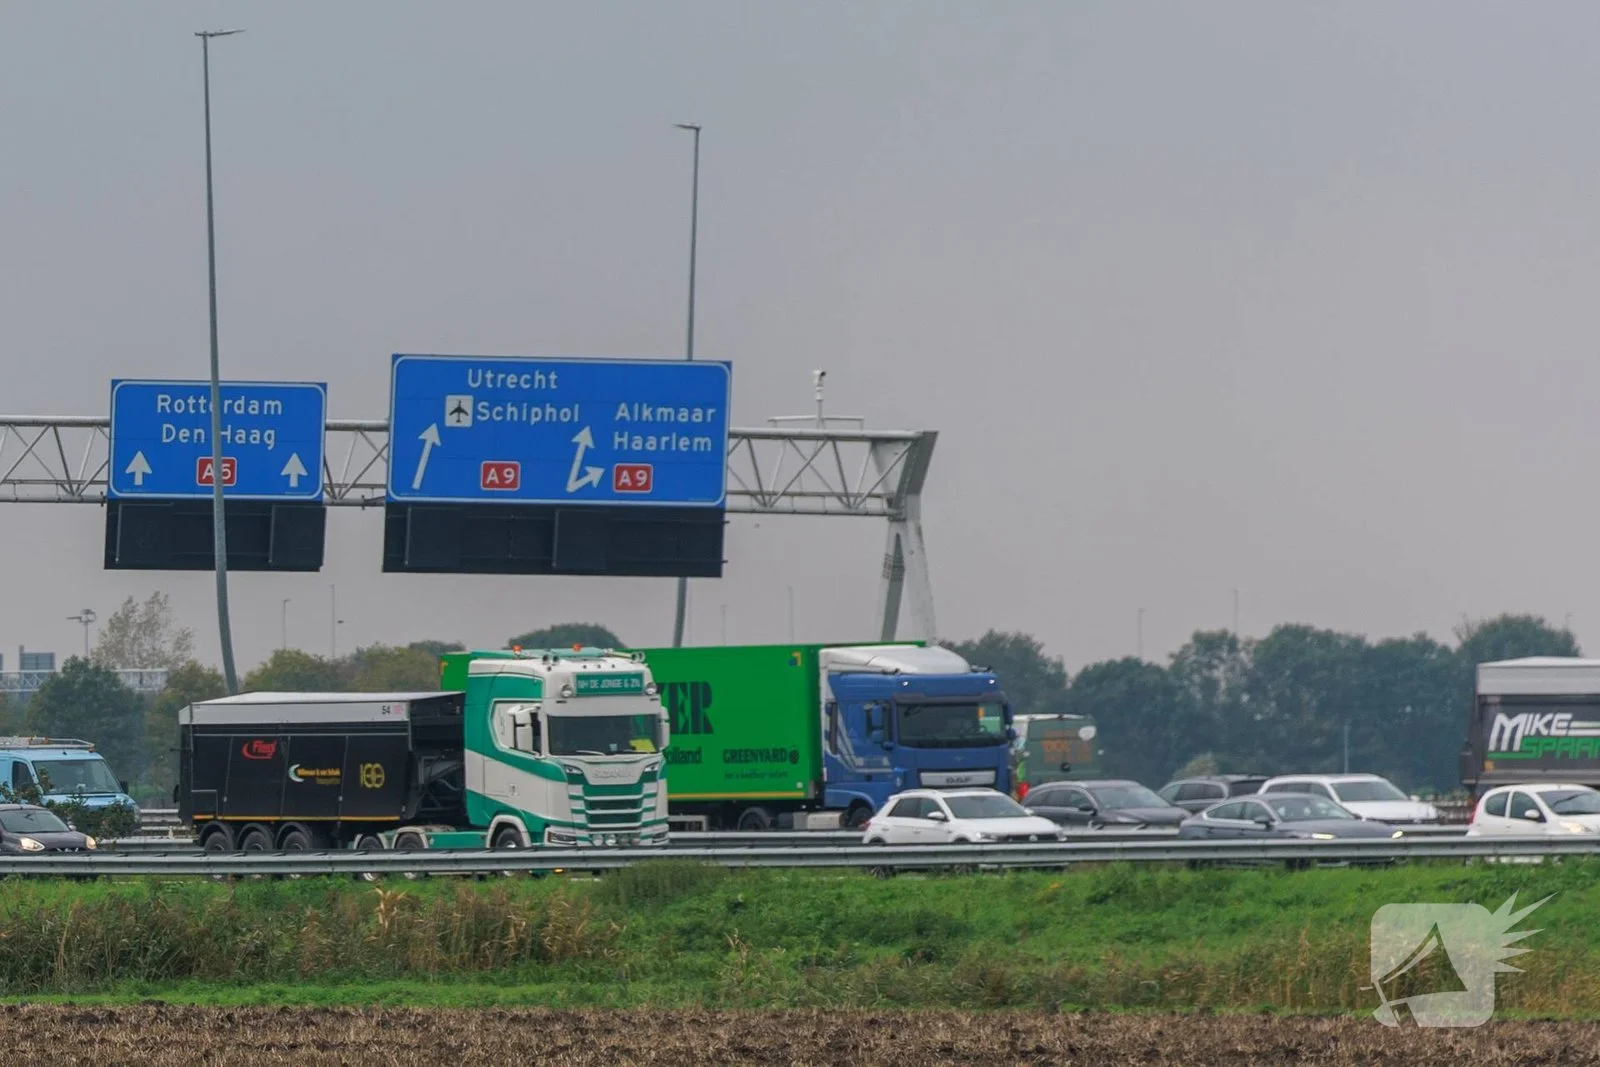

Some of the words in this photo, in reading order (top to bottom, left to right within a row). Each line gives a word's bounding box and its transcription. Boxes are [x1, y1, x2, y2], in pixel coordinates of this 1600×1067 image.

[467, 368, 558, 389] Utrecht
[476, 401, 580, 426] Schiphol
[615, 402, 717, 423] Alkmaar
[161, 423, 206, 444] Den
[613, 431, 713, 452] Haarlem
[485, 467, 516, 485] A9
[617, 469, 649, 487] A9
[656, 681, 714, 734] ER
[1489, 712, 1572, 751] MIKE
[664, 746, 702, 764] olland
[723, 748, 787, 764] GREENYARD
[945, 774, 974, 785] DAF
